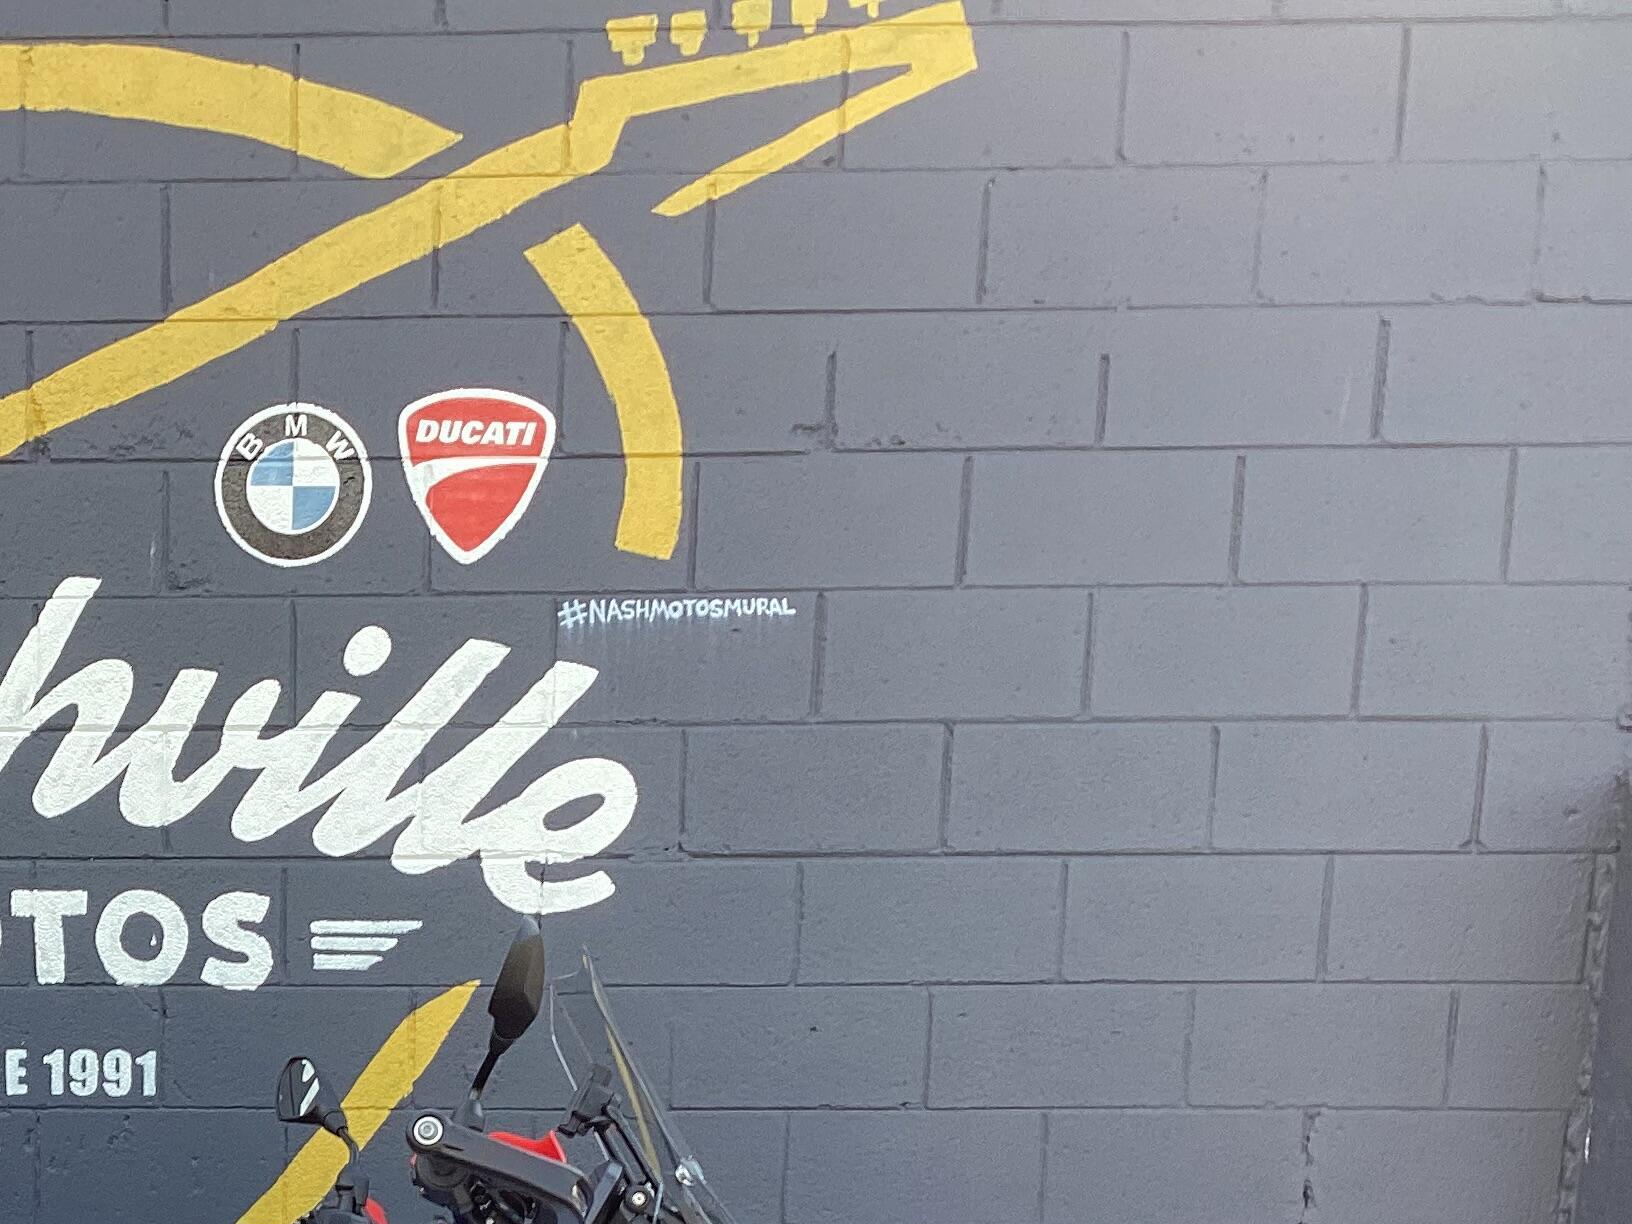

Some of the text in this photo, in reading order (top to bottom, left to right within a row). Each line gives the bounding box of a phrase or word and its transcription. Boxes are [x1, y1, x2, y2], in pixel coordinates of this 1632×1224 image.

[236, 413, 355, 461] BMW
[415, 418, 538, 446] DUCATI
[557, 597, 796, 629] #NASHMOTOSMURAL
[42, 1048, 157, 1098] 1991
